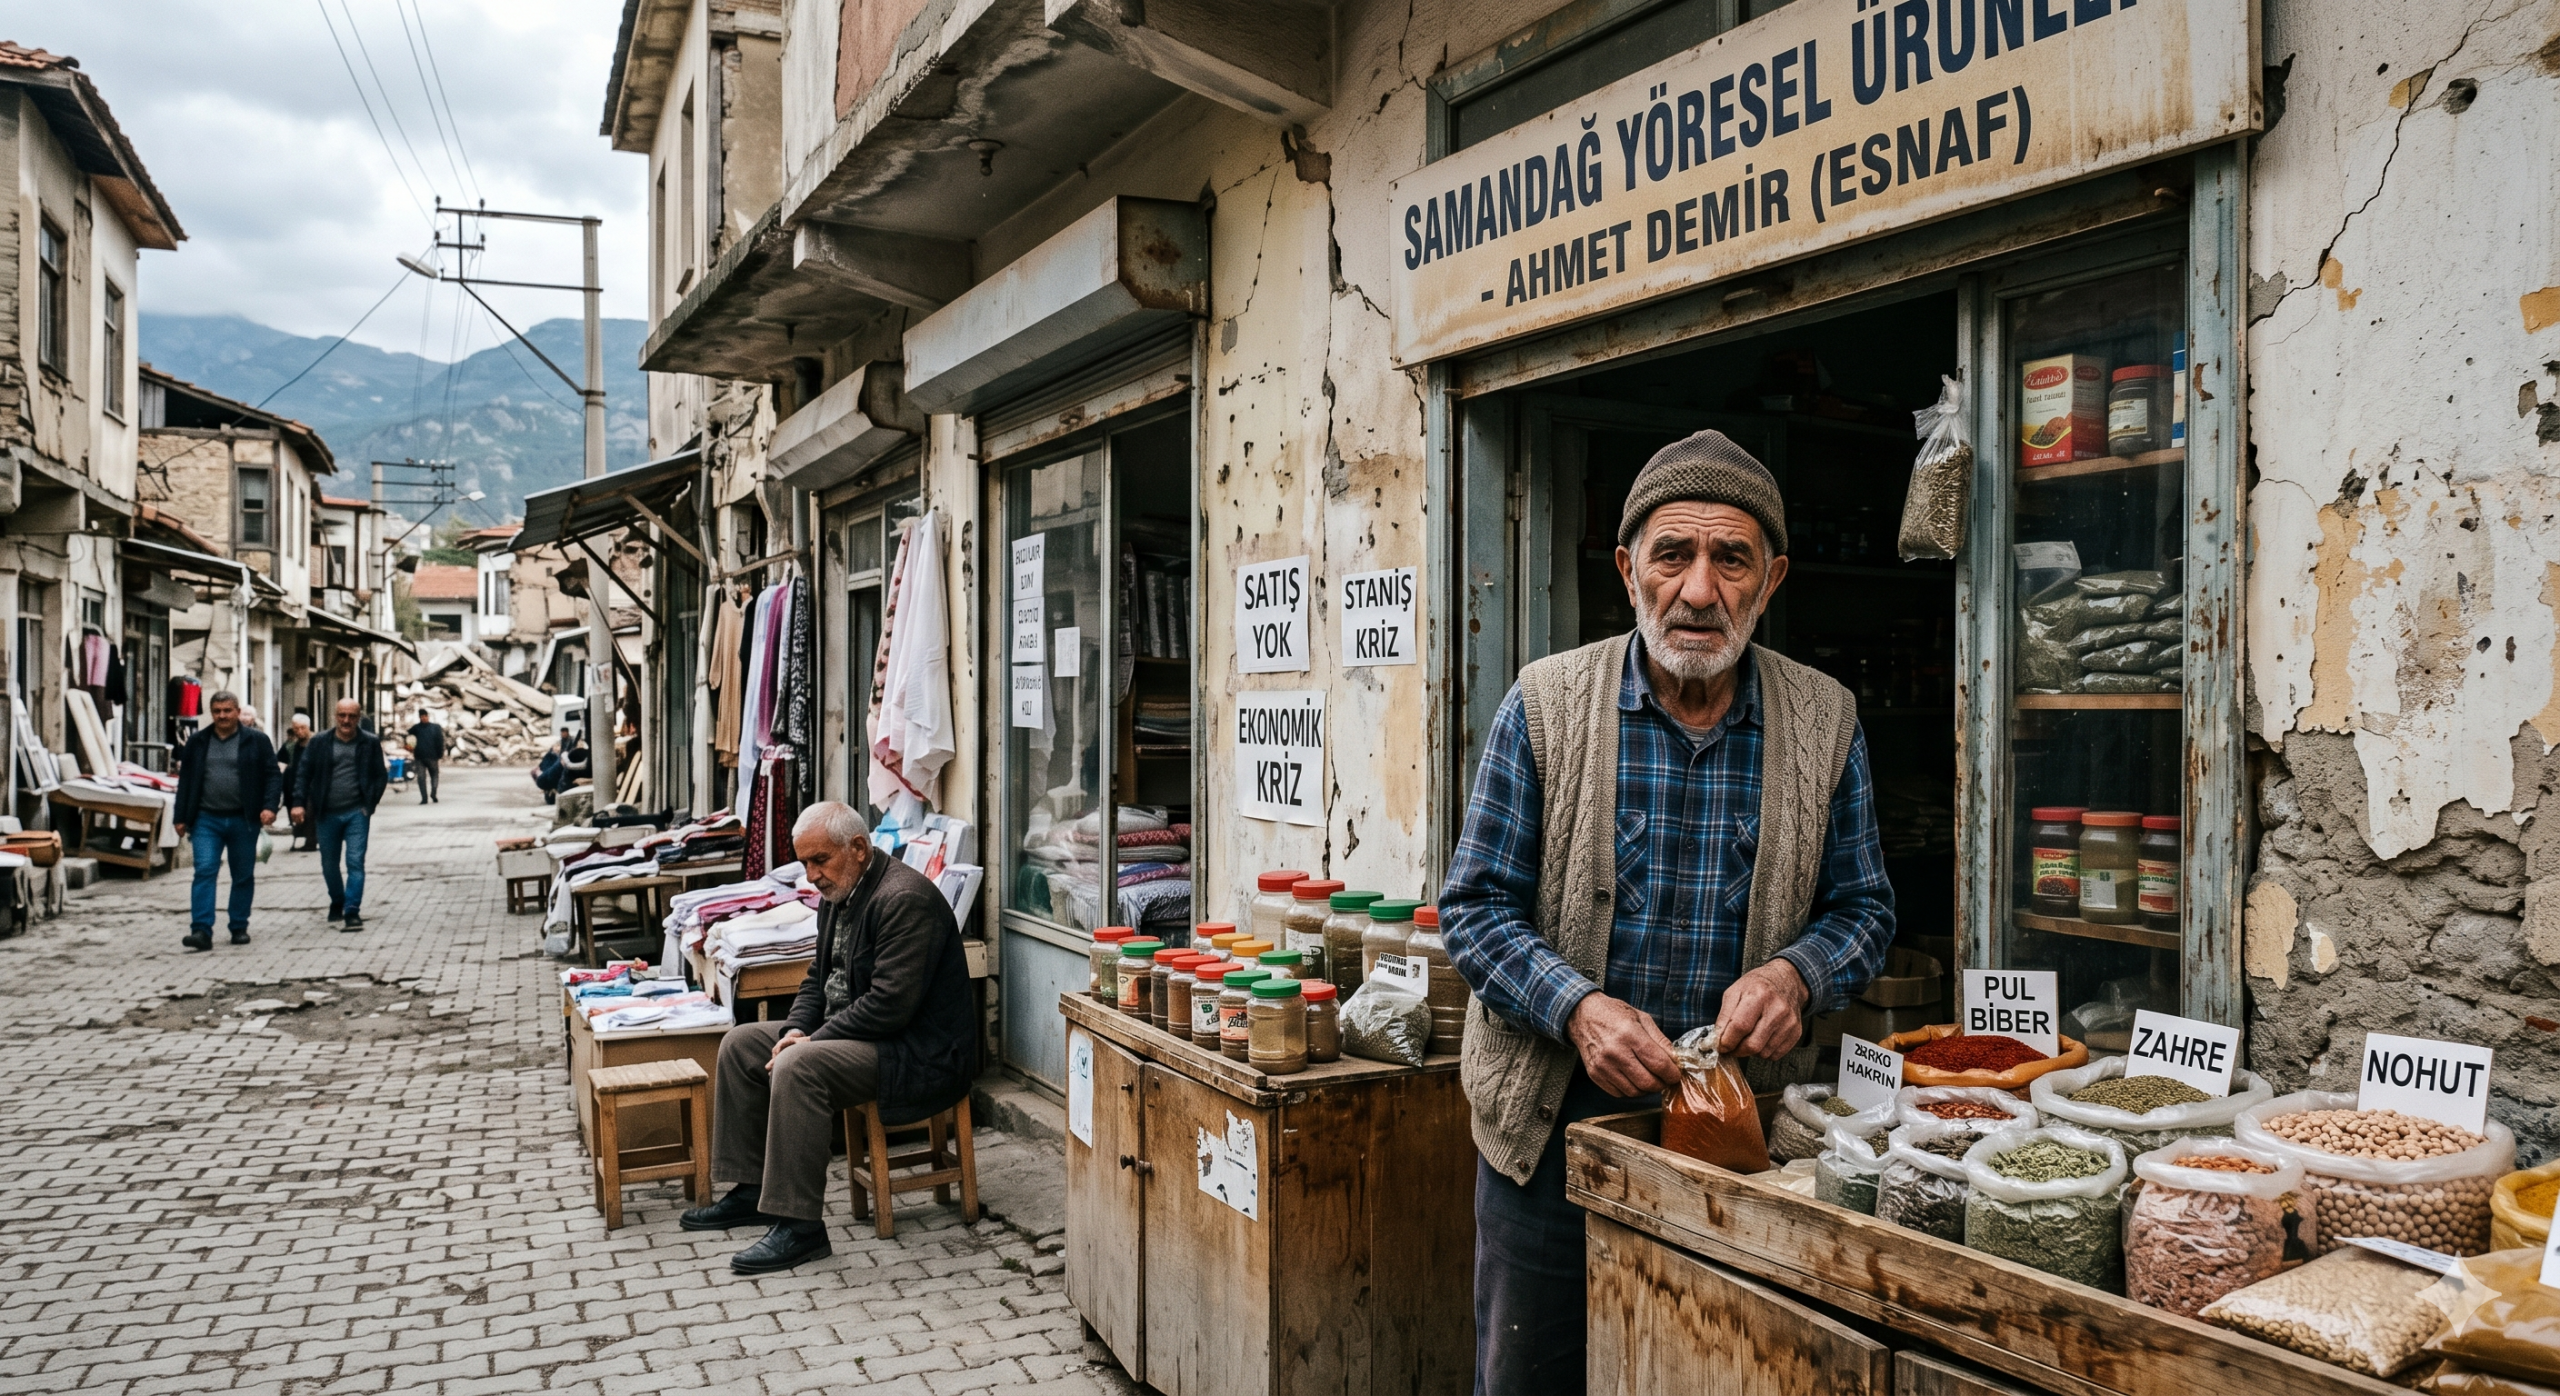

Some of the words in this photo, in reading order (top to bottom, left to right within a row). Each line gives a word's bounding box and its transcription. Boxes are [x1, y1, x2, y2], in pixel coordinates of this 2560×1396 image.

[1404, 112, 1602, 271] SAMANDAĞ
[1616, 39, 1832, 192] YÖRESEL
[1481, 289, 1495, 303] -
[1505, 220, 1632, 307] AHMET
[1647, 164, 1791, 264] DEMİR
[1811, 85, 2032, 224] (ESNAF)
[1244, 567, 1301, 613] SATIŞ
[1345, 568, 1412, 612] STANİŞ
[1252, 621, 1293, 659] YOK
[1356, 619, 1400, 659] KRİZ
[1239, 698, 1322, 748] EKONOMİK
[1257, 751, 1302, 807] KRİZ
[1984, 976, 2036, 1001] PUL
[1970, 1002, 2052, 1035] BİBER
[2133, 1027, 2228, 1074] ZAHRE
[2367, 1049, 2485, 1098] NOHUT
[1846, 1059, 1896, 1090] HAKRIN
